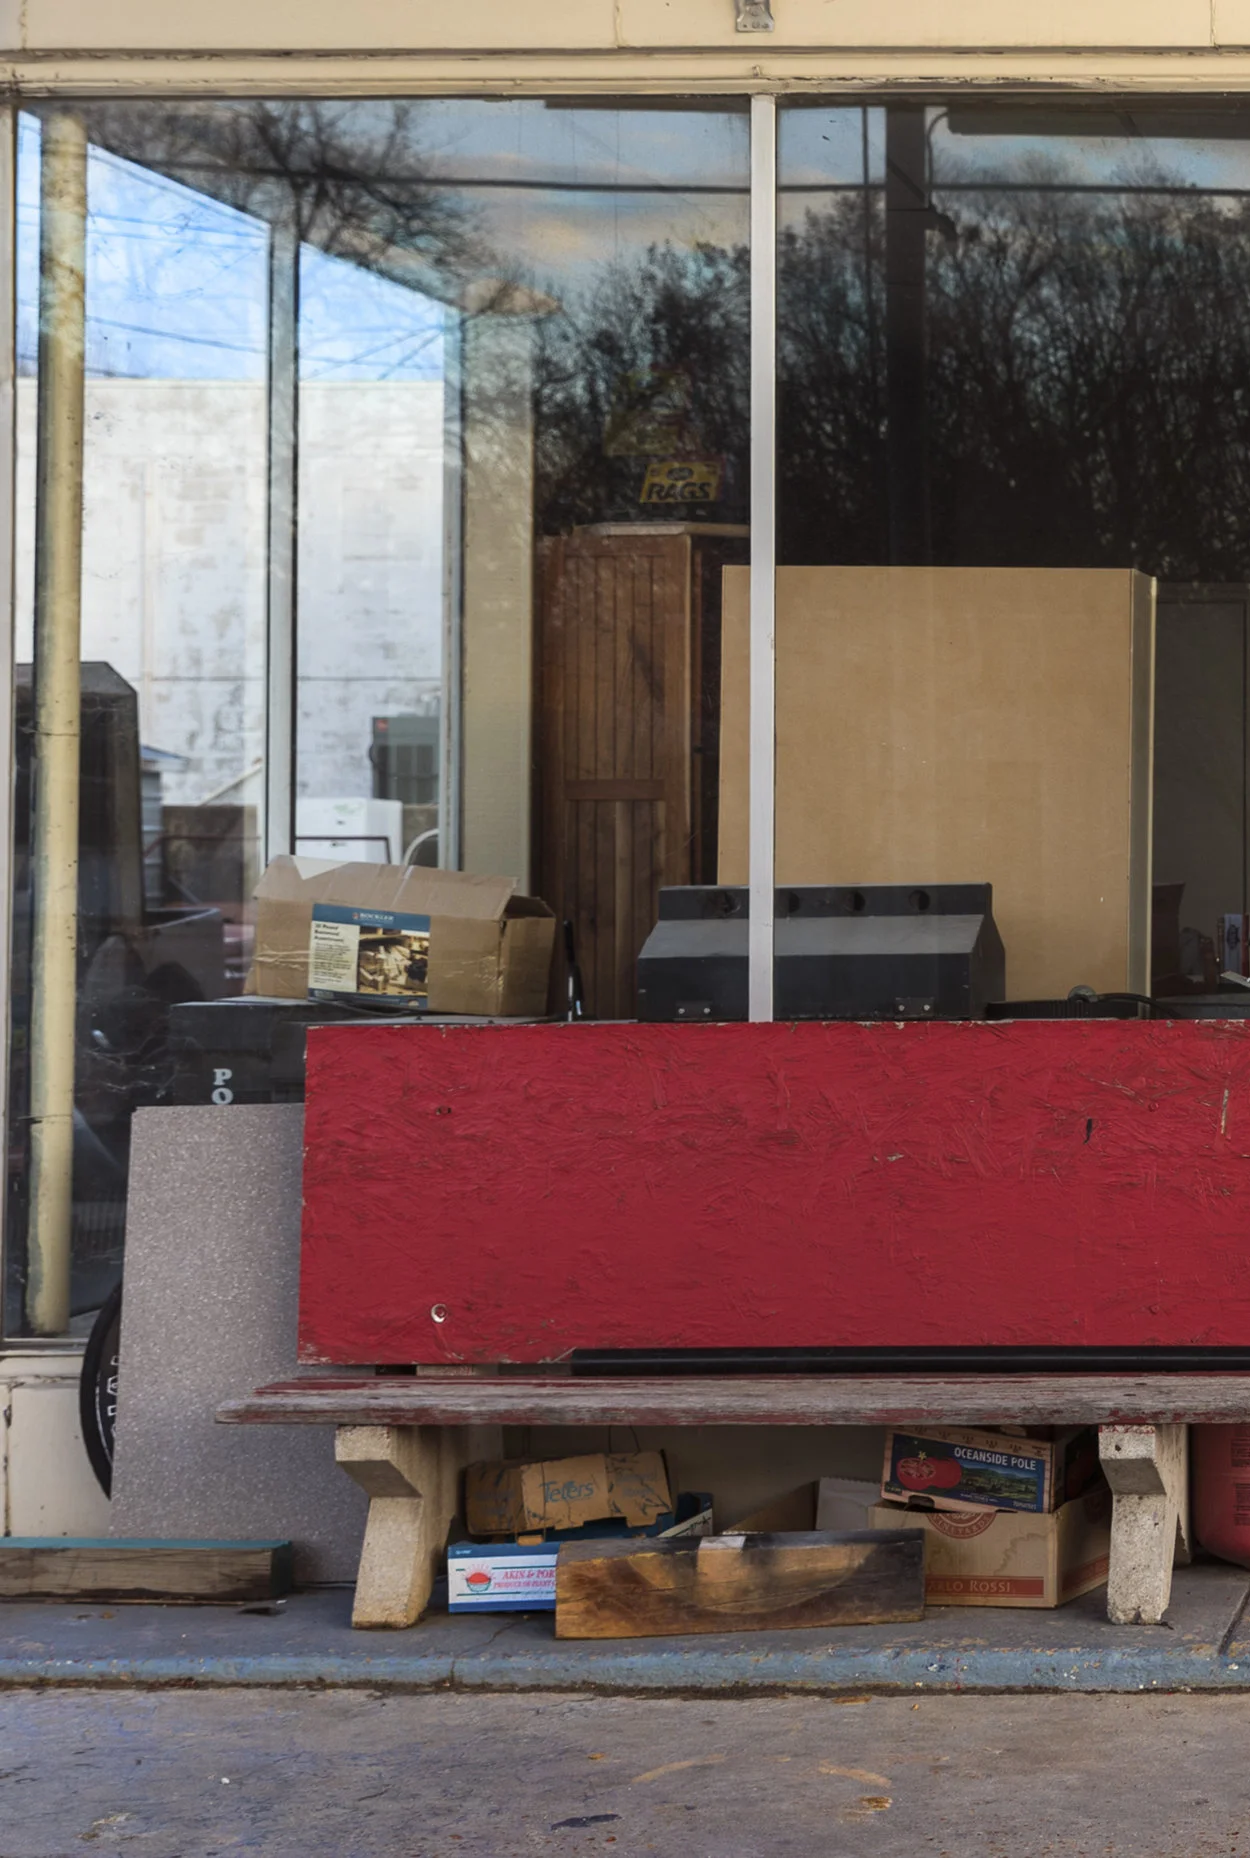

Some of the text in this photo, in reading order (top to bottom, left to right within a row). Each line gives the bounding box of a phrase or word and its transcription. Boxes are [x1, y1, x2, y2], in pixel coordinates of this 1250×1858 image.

[647, 482, 712, 500] RAGS
[954, 1446, 1037, 1471] OCEANSIDE POLE
[969, 1579, 1011, 1593] ROSSI
